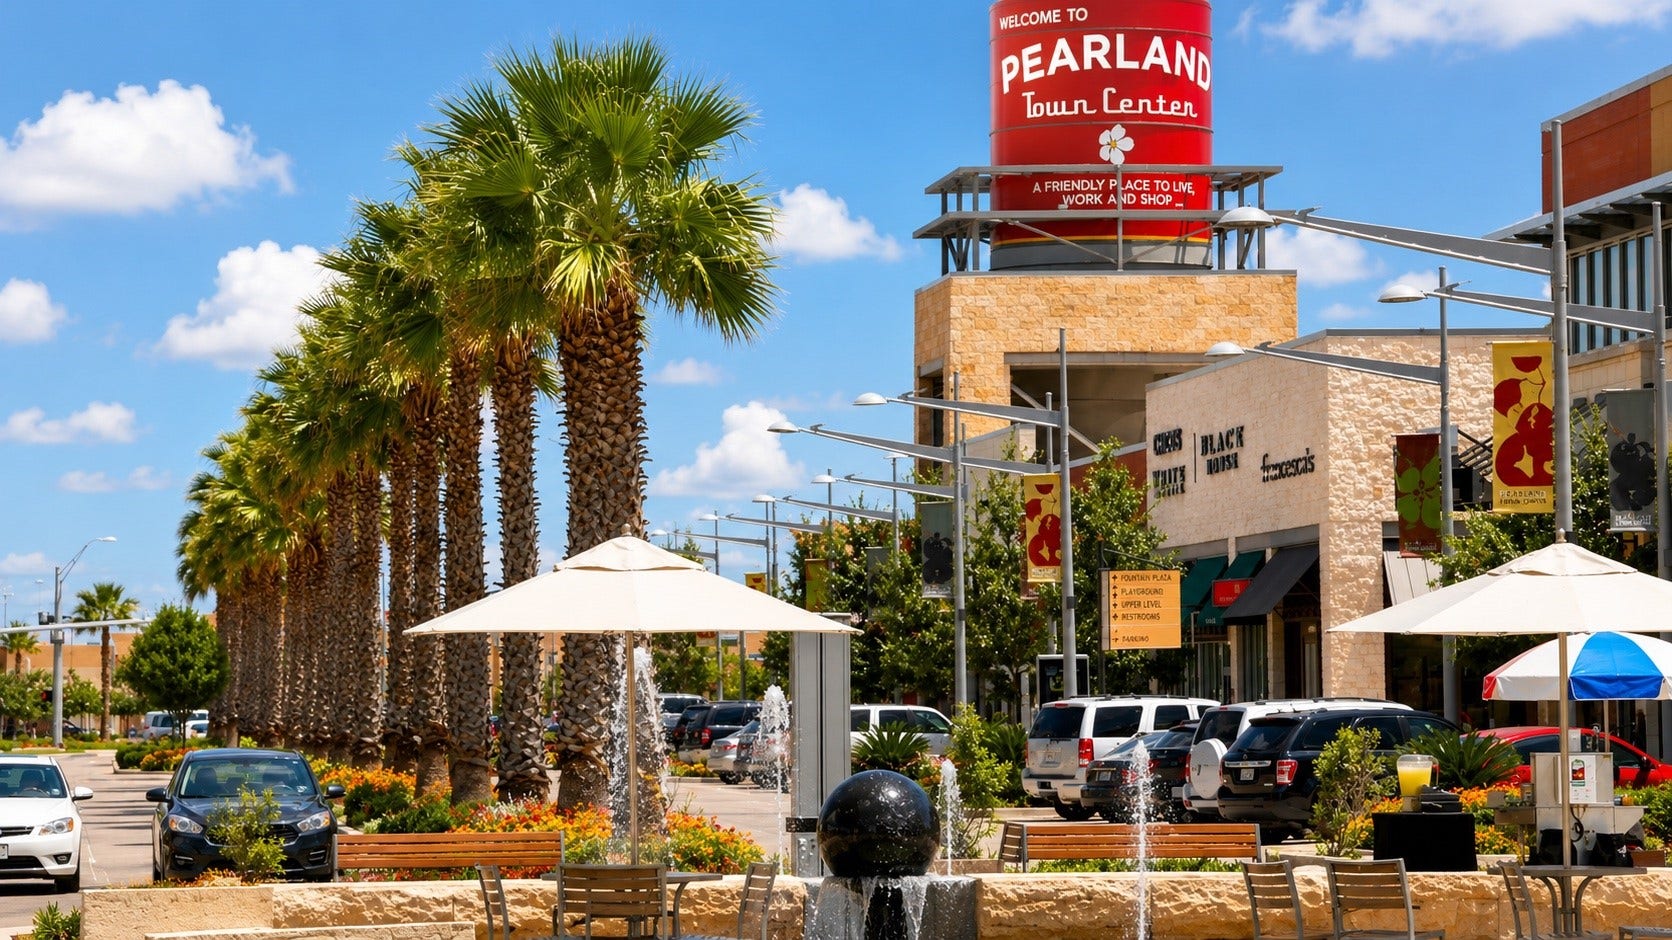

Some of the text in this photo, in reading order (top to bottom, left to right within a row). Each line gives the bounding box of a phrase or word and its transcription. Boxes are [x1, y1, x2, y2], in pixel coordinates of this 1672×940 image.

[1000, 7, 1088, 30] WELCOME TO
[1001, 33, 1211, 94] PEARLAND
[1022, 87, 1198, 119] Town Center
[1032, 182, 1042, 193] A
[1044, 179, 1105, 192] FRIENDLY
[1153, 180, 1170, 192] TO
[1172, 181, 1195, 196] LIVE,
[1062, 193, 1173, 205] WORK AND SHOP
[1200, 425, 1245, 457] BLACK
[1121, 600, 1162, 609] UPPER LEVEL
